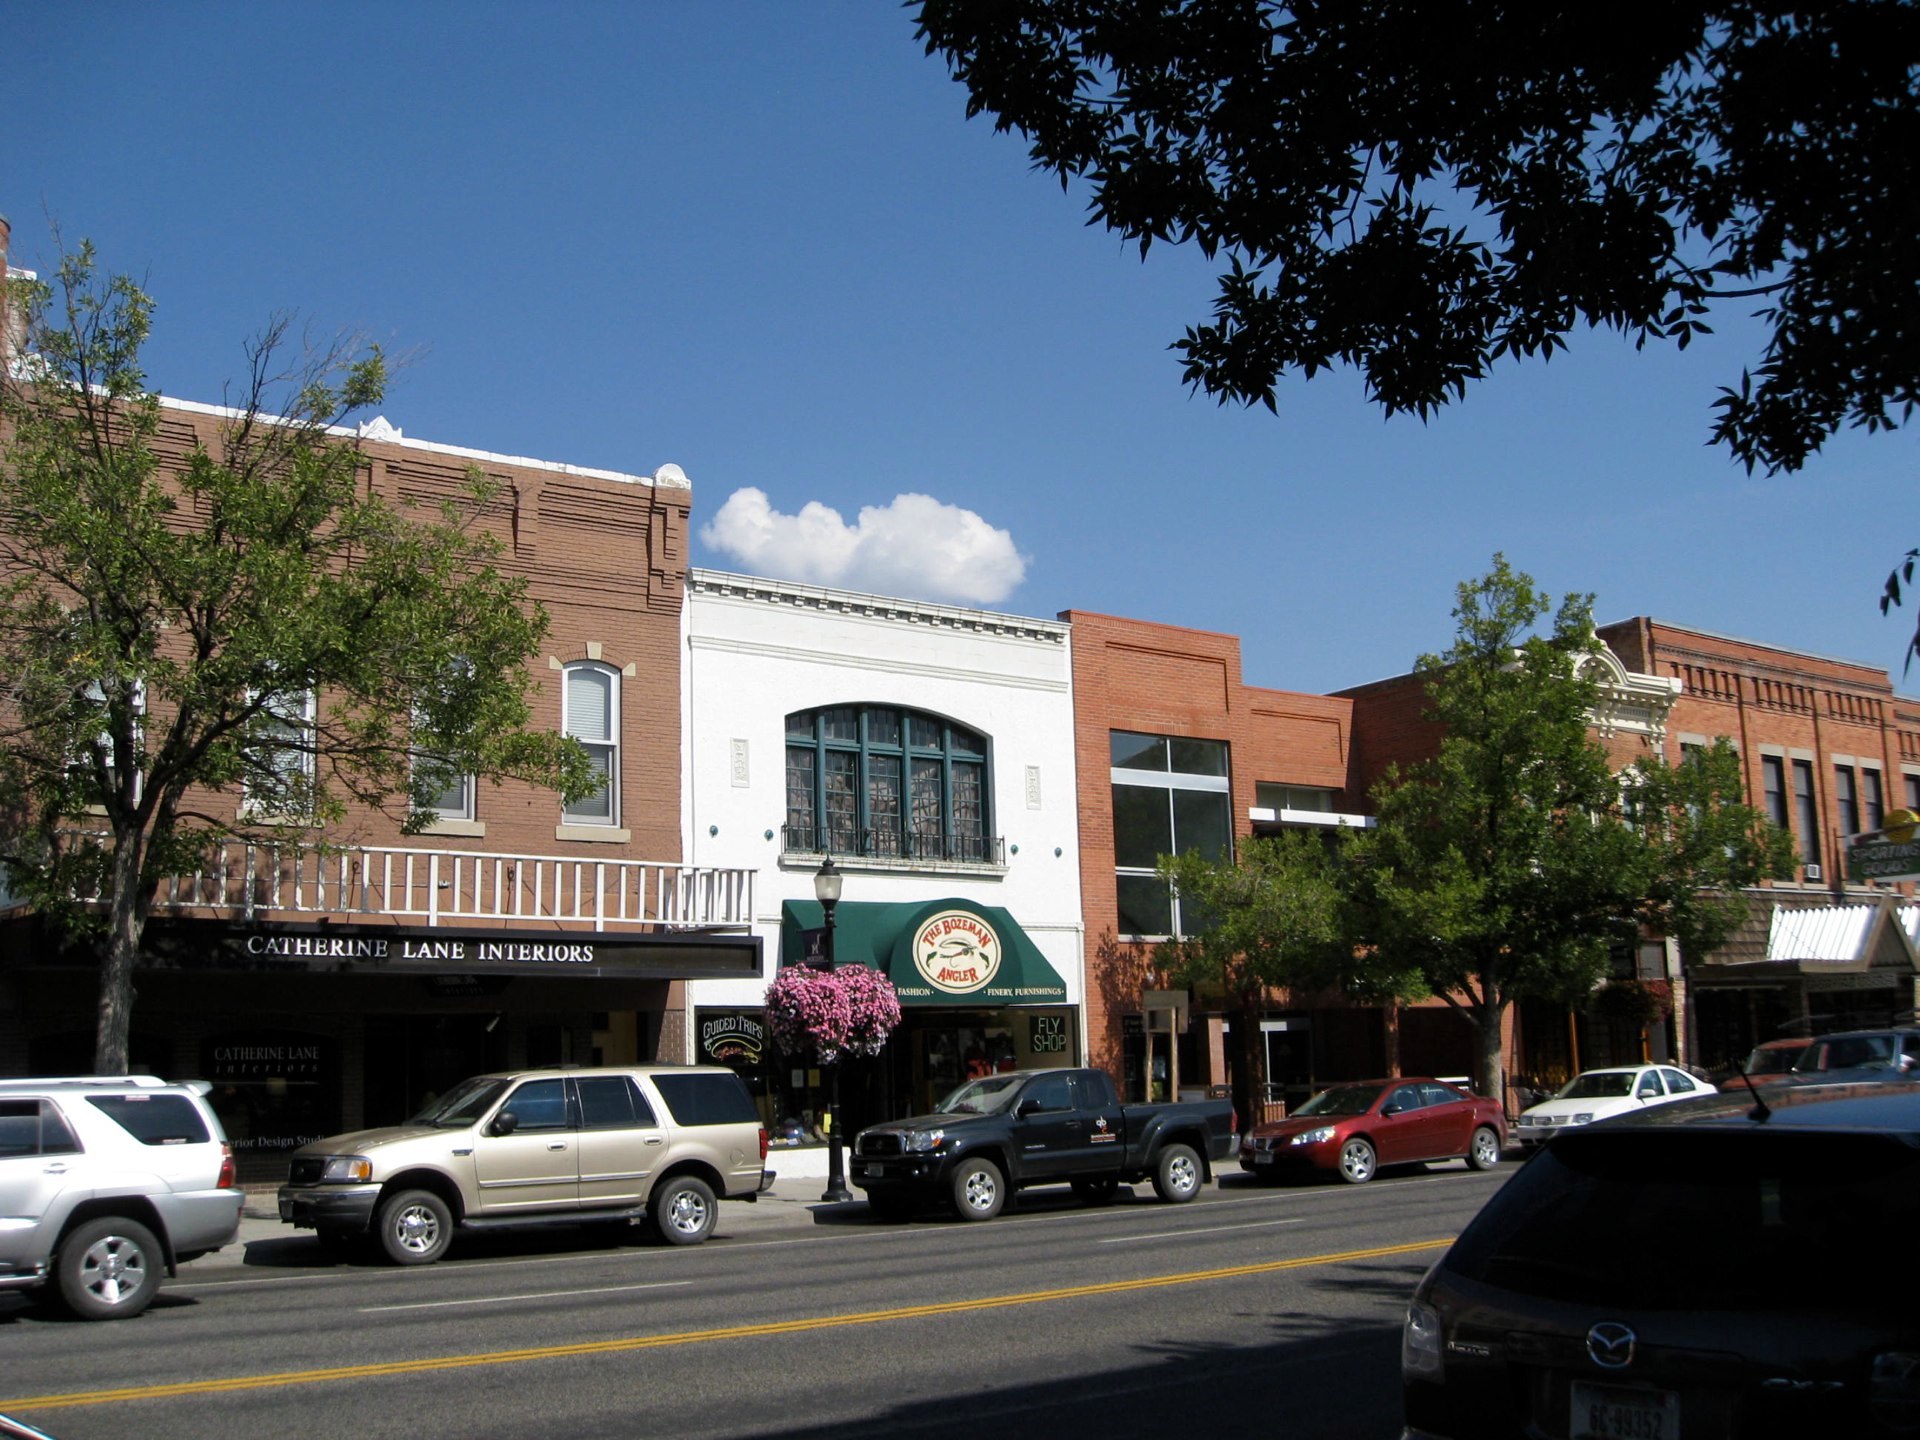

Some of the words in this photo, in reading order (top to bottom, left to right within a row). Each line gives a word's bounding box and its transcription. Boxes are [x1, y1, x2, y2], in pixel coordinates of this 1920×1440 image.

[922, 924, 942, 947] THE
[942, 918, 992, 948] BOZEMAN
[247, 936, 388, 957] CATHERINE
[402, 941, 465, 959] LANE
[478, 942, 594, 962] INTERIORS
[937, 967, 979, 983] ANGLER
[897, 987, 931, 996] FASHION
[987, 988, 1014, 997] FINERY,
[1015, 987, 1062, 996] FURNISHINGS
[703, 1017, 736, 1039] GUIDED
[736, 1015, 763, 1040] TRIPS
[1038, 1017, 1060, 1035] FLY
[1034, 1034, 1067, 1052] SHOP
[214, 1045, 285, 1061] CATHERINE
[288, 1045, 320, 1060] LANE
[215, 1062, 318, 1073] interiors
[257, 1135, 295, 1149] Design
